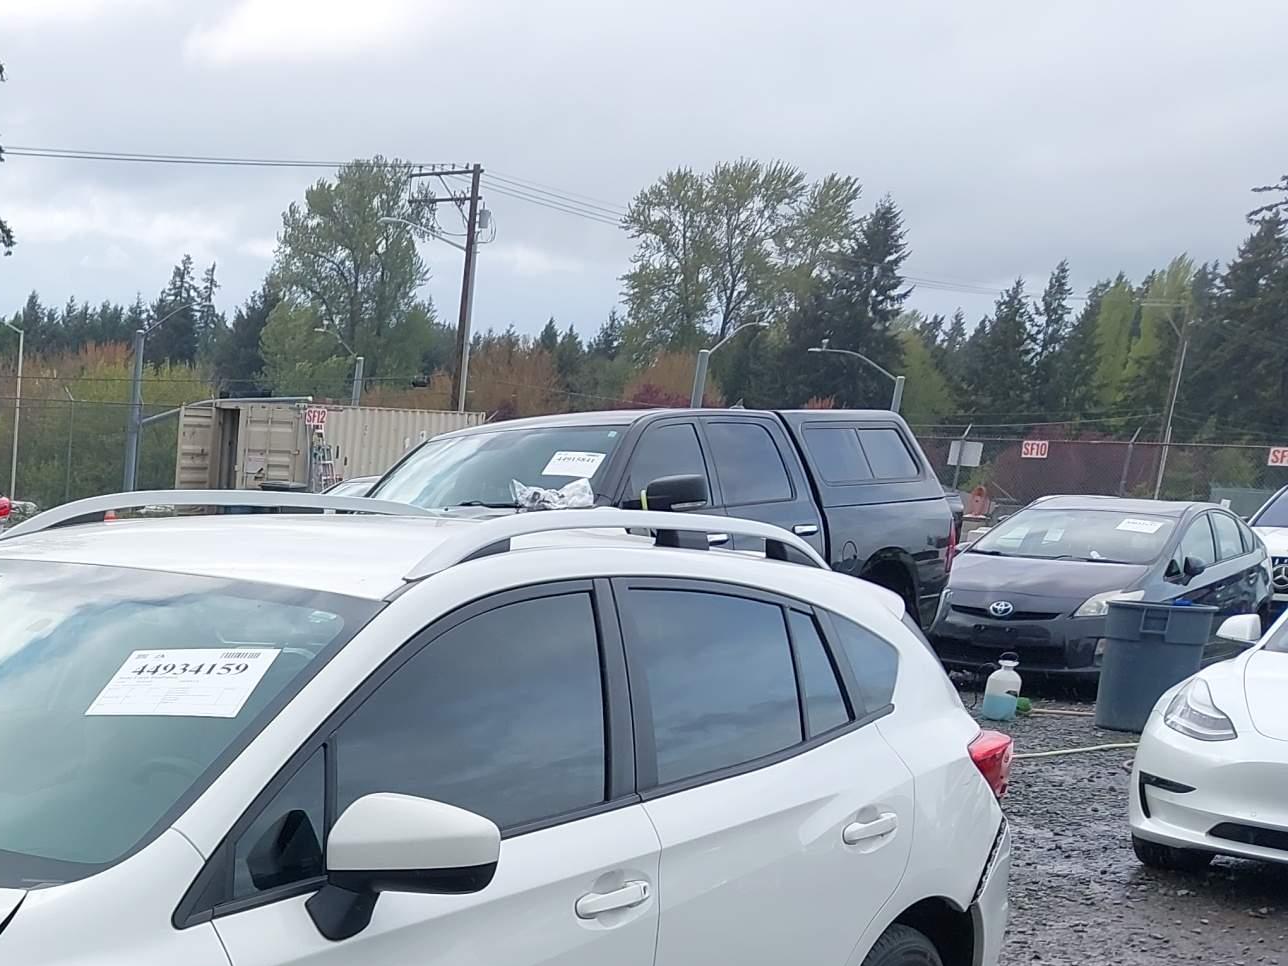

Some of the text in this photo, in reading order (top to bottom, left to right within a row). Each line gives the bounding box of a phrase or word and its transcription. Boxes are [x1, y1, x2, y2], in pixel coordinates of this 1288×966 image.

[306, 409, 327, 424] SF12
[1023, 442, 1048, 457] SF10
[131, 662, 249, 676] 44934159
